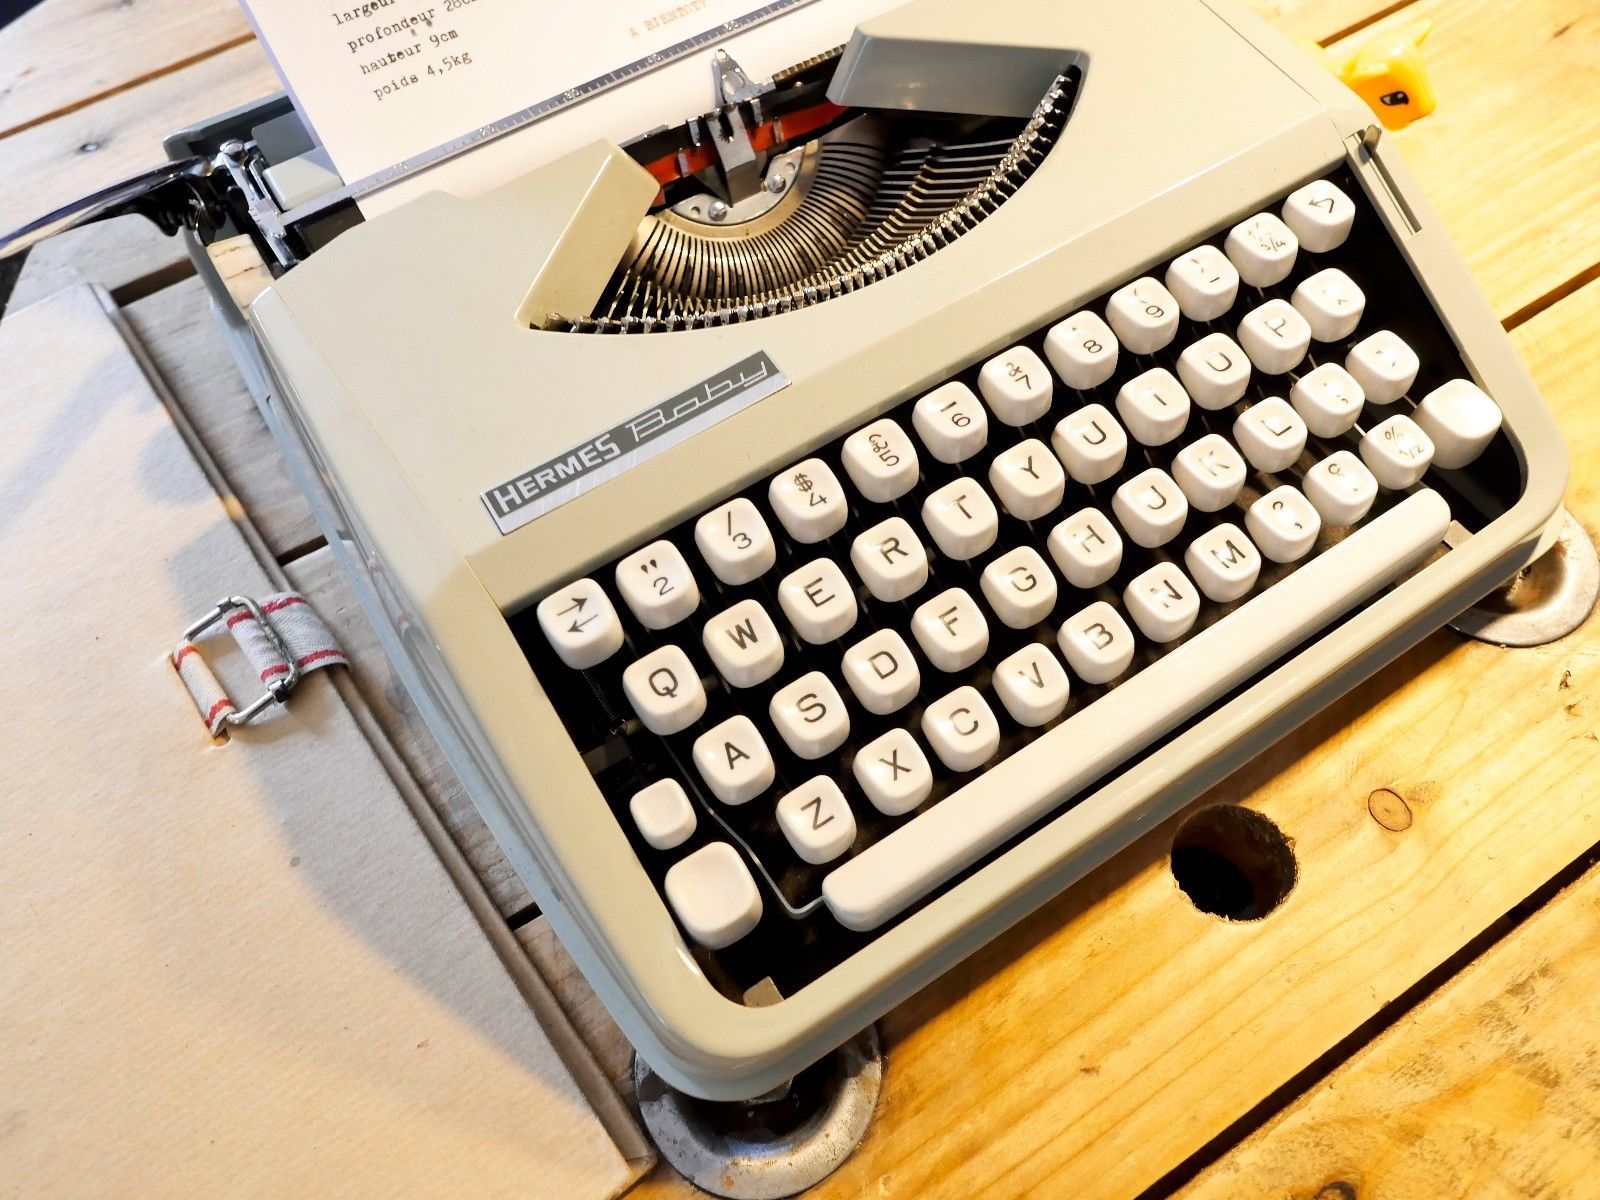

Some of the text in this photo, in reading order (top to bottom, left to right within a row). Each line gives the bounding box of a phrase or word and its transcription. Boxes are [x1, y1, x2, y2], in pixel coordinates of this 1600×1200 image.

[347, 7, 435, 53] profondeur
[360, 28, 459, 75] hauteur 9cm
[373, 52, 473, 100] poids 4,5kg
[1145, 305, 1165, 318] 9
[1083, 340, 1102, 354] 8
[1015, 374, 1032, 390] 7
[951, 412, 971, 427] 6
[1082, 420, 1107, 446] U
[492, 361, 769, 513] HERMES Baby
[879, 449, 900, 467] 5
[1020, 455, 1040, 480] Y
[793, 472, 813, 493] $
[808, 492, 828, 507] 4
[1147, 485, 1167, 511] J
[732, 532, 752, 550] 3
[879, 537, 909, 565] R
[1210, 539, 1247, 569] M
[653, 576, 675, 597] 2
[803, 577, 835, 608] E
[1008, 566, 1037, 593] G
[725, 618, 759, 650] W
[938, 606, 960, 637] F
[867, 650, 899, 680] D
[1018, 661, 1045, 689] V
[648, 667, 678, 698] Q
[796, 692, 827, 724] S
[949, 707, 979, 737] C
[724, 741, 750, 770] A
[878, 749, 912, 781] X
[800, 796, 835, 831] Z
